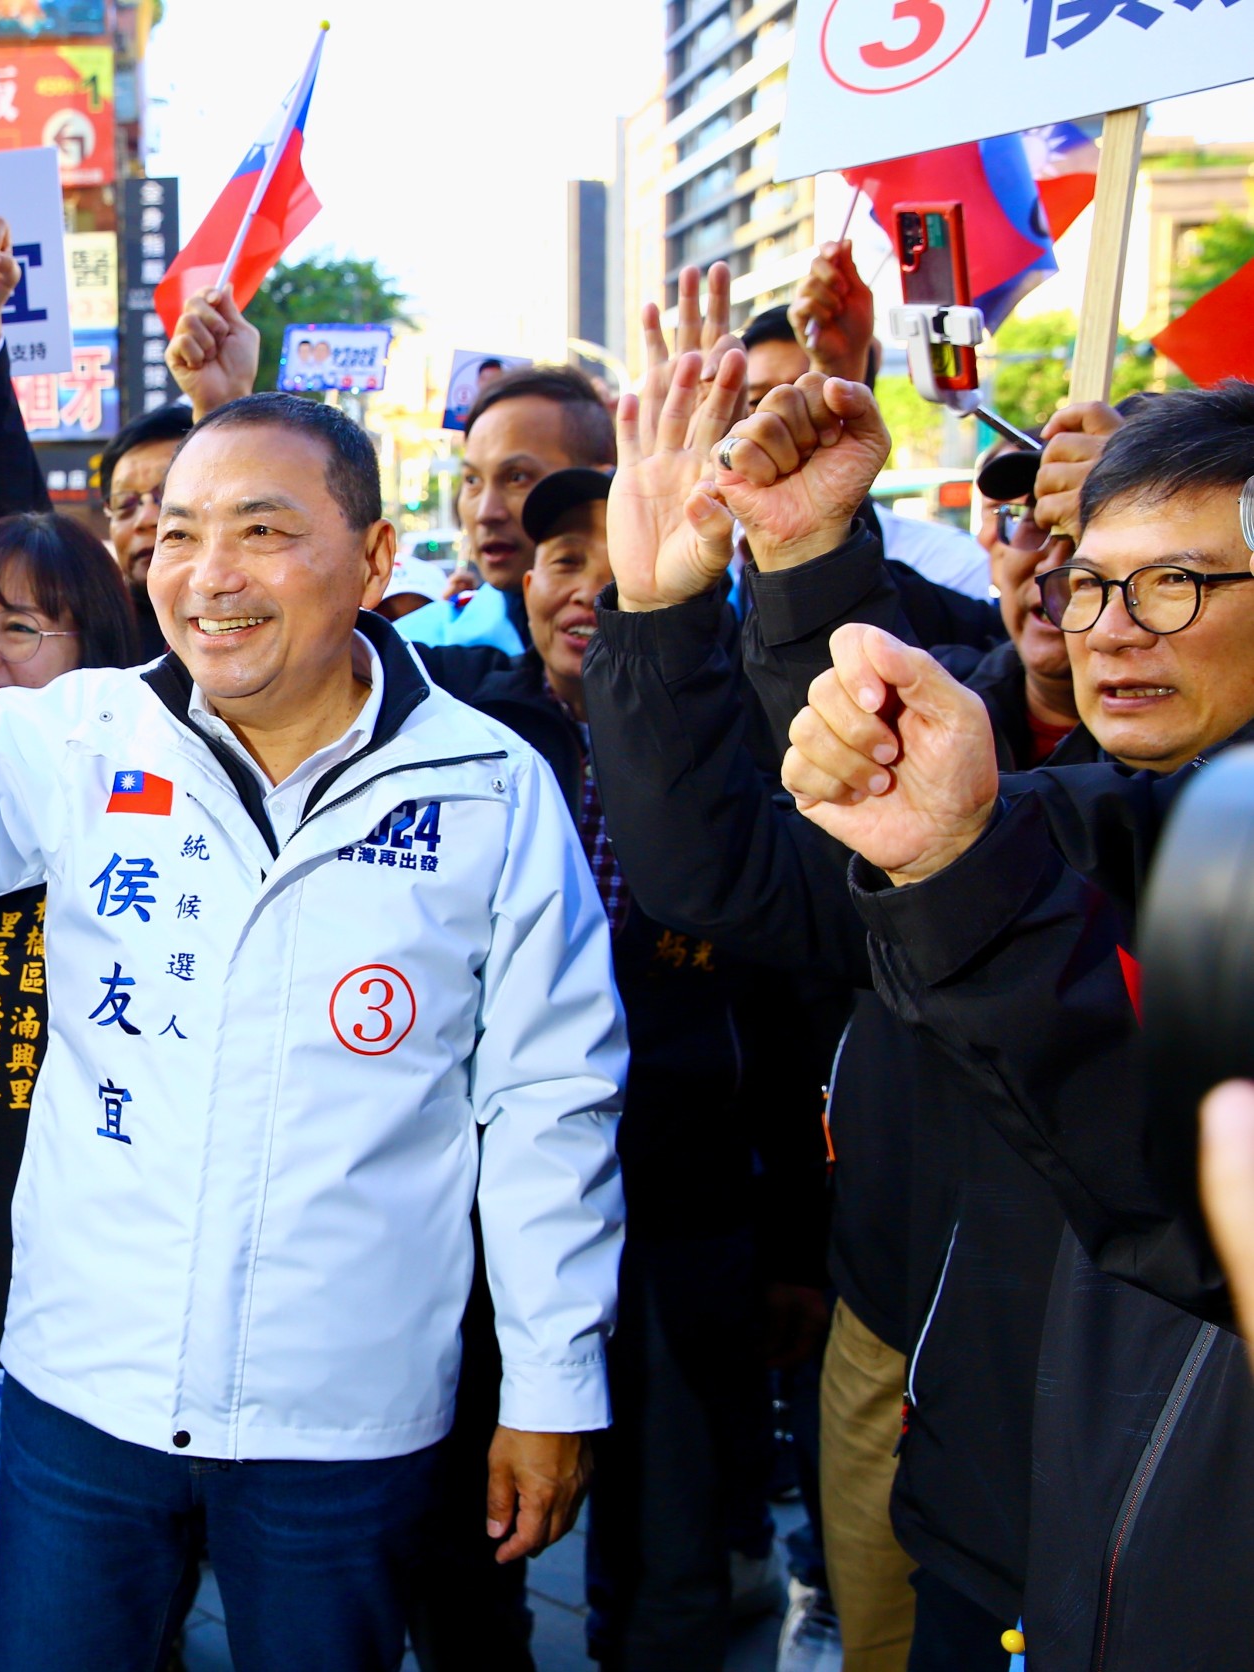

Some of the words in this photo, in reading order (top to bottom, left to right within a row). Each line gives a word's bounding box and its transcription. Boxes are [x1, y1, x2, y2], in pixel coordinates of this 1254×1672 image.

[337, 846, 439, 873] 台灣再出發
[88, 852, 160, 1145] 侯友宜
[353, 978, 395, 1042] 3
